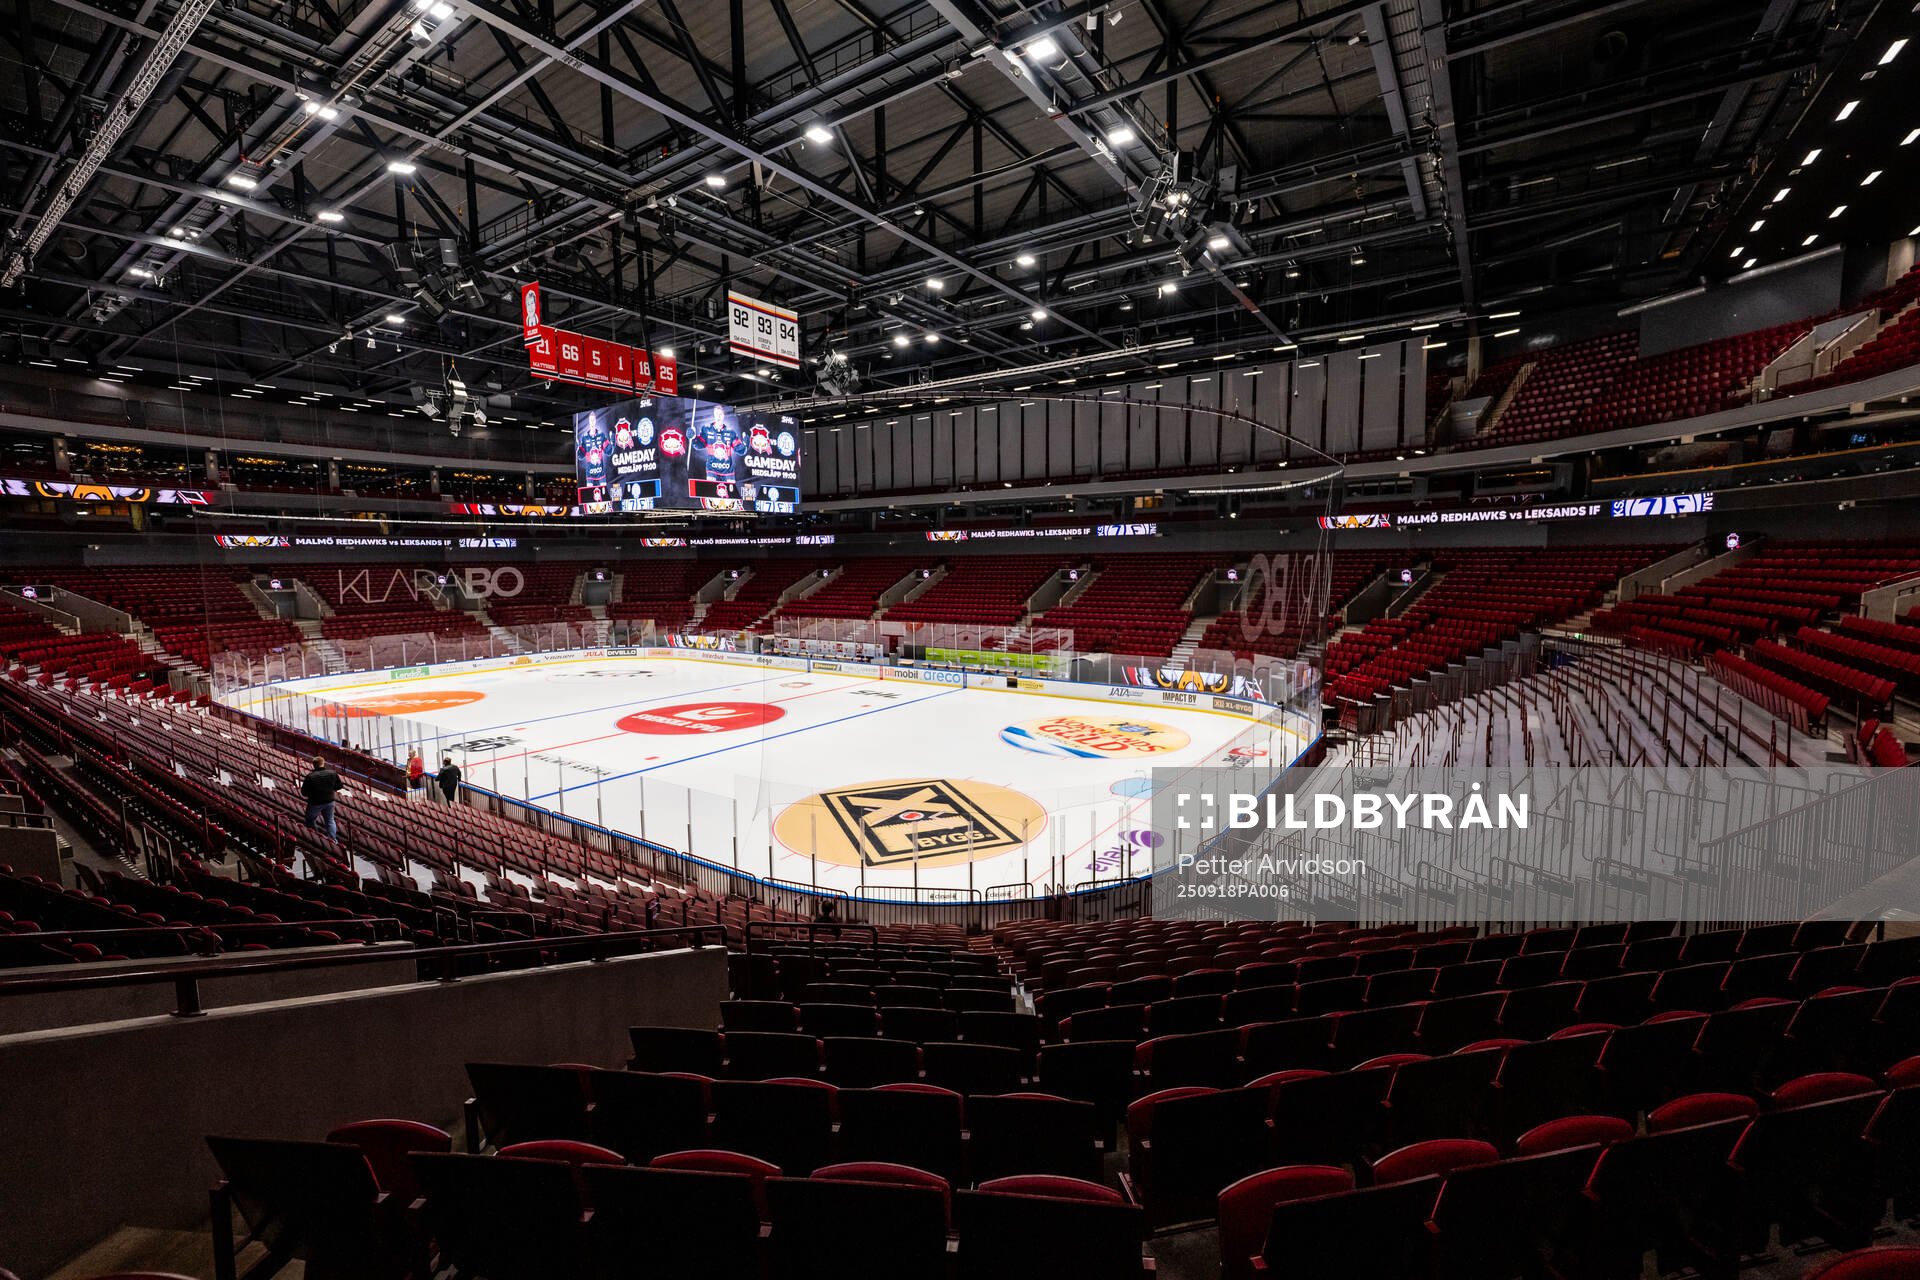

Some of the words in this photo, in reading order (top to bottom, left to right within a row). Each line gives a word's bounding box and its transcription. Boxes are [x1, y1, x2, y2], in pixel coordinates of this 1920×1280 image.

[733, 308, 749, 329] 92
[757, 316, 772, 335] 93
[780, 323, 796, 342] 94
[536, 338, 551, 355] 21
[562, 344, 579, 361] 66
[592, 350, 601, 366] 5
[618, 356, 624, 371] 1
[639, 361, 651, 376] 18
[659, 365, 674, 381] 25
[612, 448, 656, 466] GAMEDAY
[744, 455, 796, 472] GAMEDAY
[643, 462, 657, 472] 19:00
[782, 472, 797, 480] 19:00
[1396, 510, 1438, 525] MALMÖ
[1440, 509, 1507, 524] REDHAWKS
[1509, 511, 1523, 520] vs
[1524, 506, 1587, 520] LEKSANDS
[1588, 504, 1601, 516] IF
[296, 537, 333, 545] MALMÖ
[690, 537, 714, 545] MALMÖ
[971, 530, 996, 538] MALMÖ
[997, 529, 1035, 538] REDHAWKS
[1045, 528, 1082, 536] LEKSANDS
[923, 671, 961, 683] areco
[1162, 692, 1186, 702] IMPACT
[1186, 694, 1197, 704] BY
